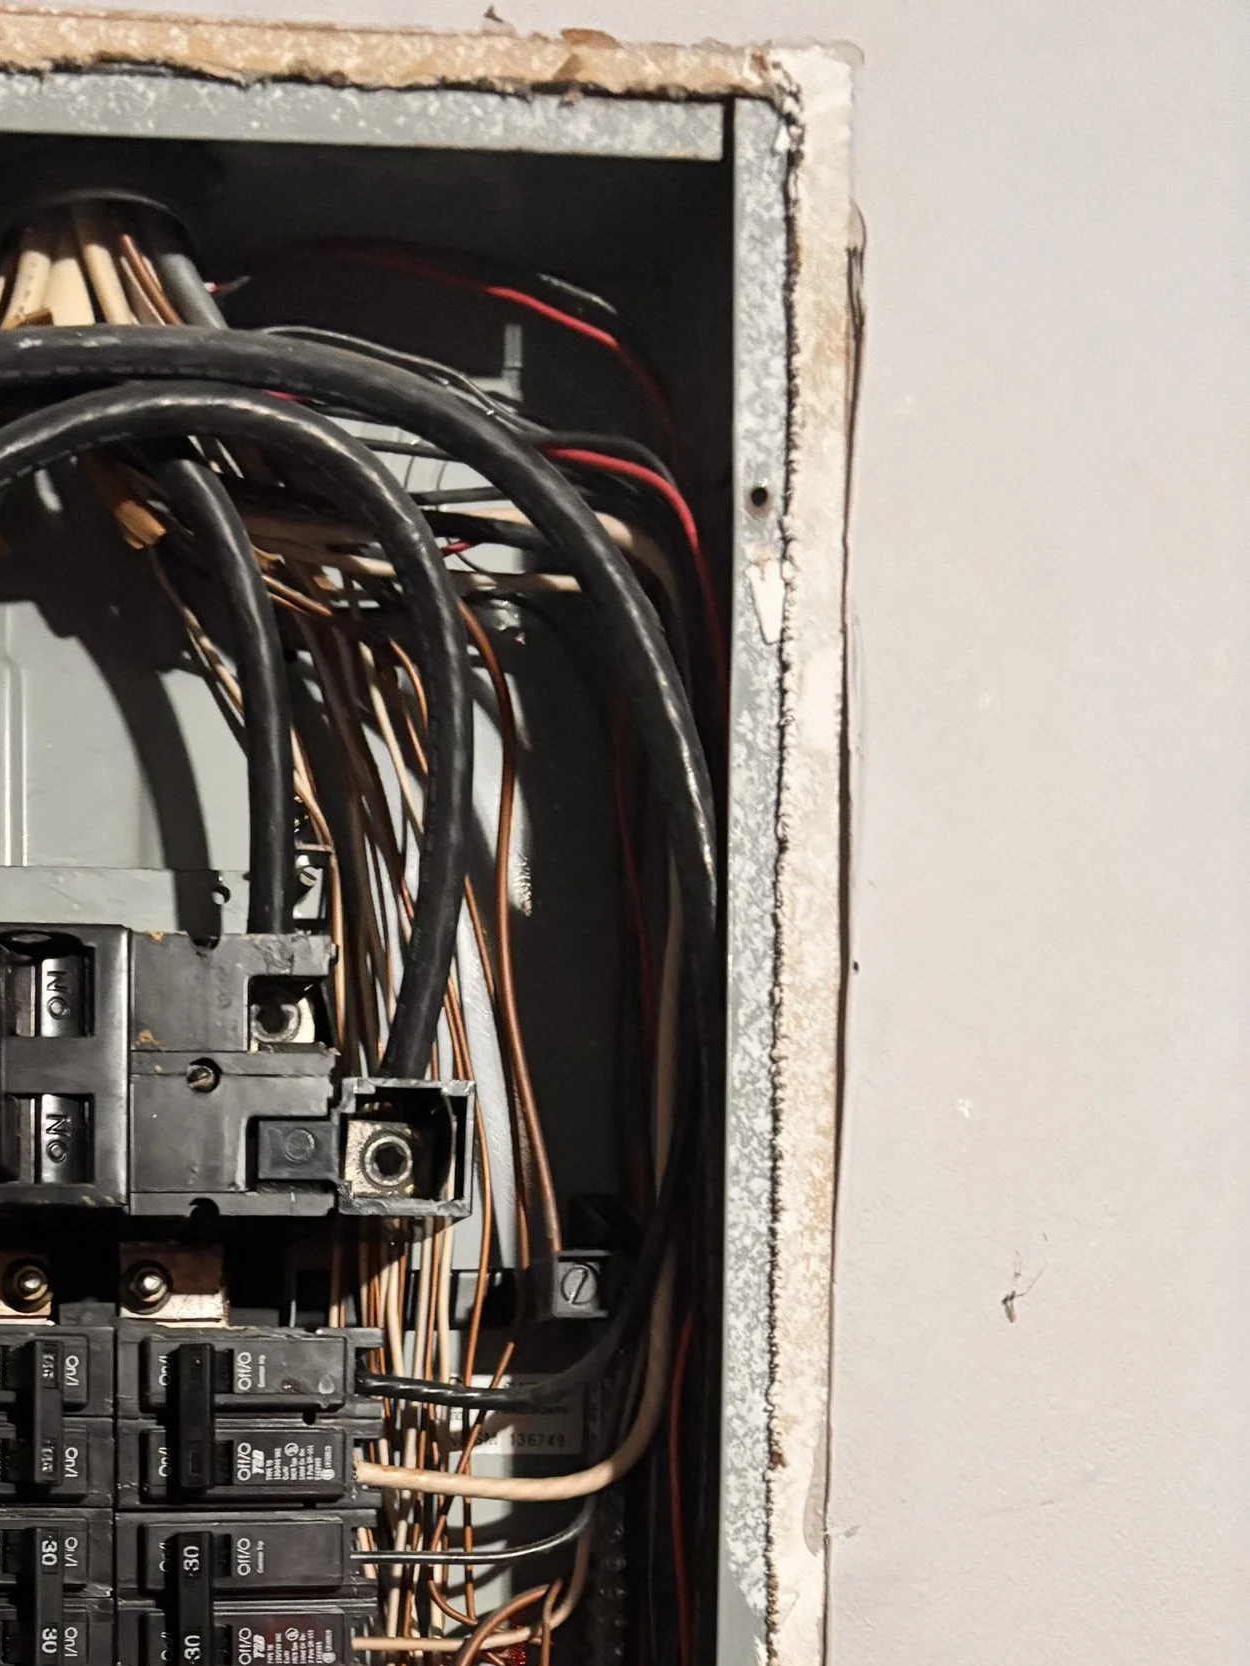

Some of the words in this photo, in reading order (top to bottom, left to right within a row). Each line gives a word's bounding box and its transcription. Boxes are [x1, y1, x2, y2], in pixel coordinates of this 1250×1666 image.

[46, 970, 69, 1021] ON
[46, 1113, 69, 1164] ON
[65, 1355, 79, 1386] On/I
[237, 1351, 251, 1390] Off/O
[65, 1447, 79, 1478] On/I
[237, 1442, 251, 1481] Off/O
[41, 1540, 58, 1566] 30
[183, 1545, 200, 1571] 30
[237, 1538, 251, 1576] Off/O
[41, 1628, 58, 1654] 30
[64, 1626, 78, 1657] On/I
[184, 1634, 201, 1660] 30
[238, 1627, 252, 1665] Off/O
